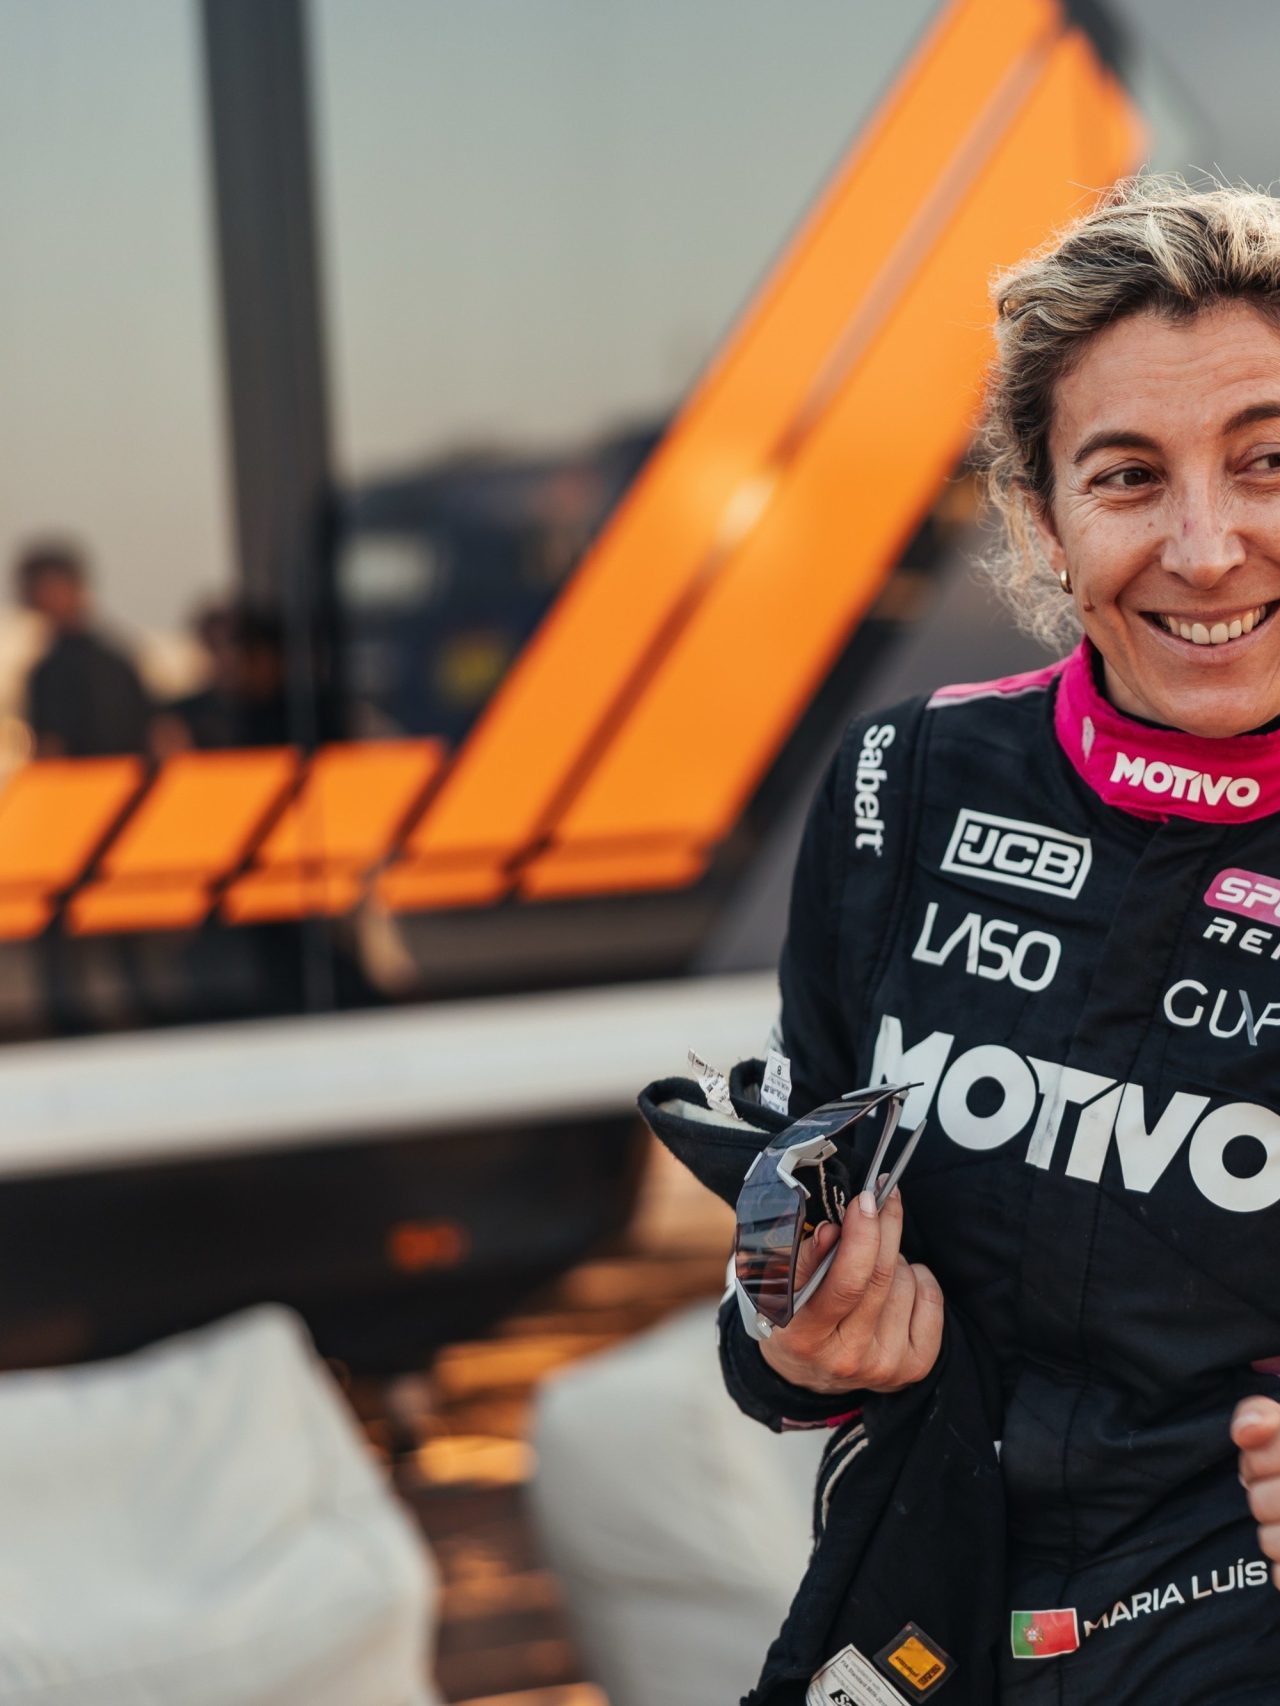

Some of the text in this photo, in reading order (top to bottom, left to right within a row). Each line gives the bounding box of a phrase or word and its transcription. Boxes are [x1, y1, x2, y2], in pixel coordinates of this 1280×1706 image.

[853, 724, 896, 853] Sabelt
[1110, 752, 1261, 808] MOTIVO
[957, 824, 1082, 885] JCB
[911, 902, 1062, 992] LASO
[1191, 1558, 1269, 1599] LUÍS
[1083, 1582, 1186, 1638] MARIA
